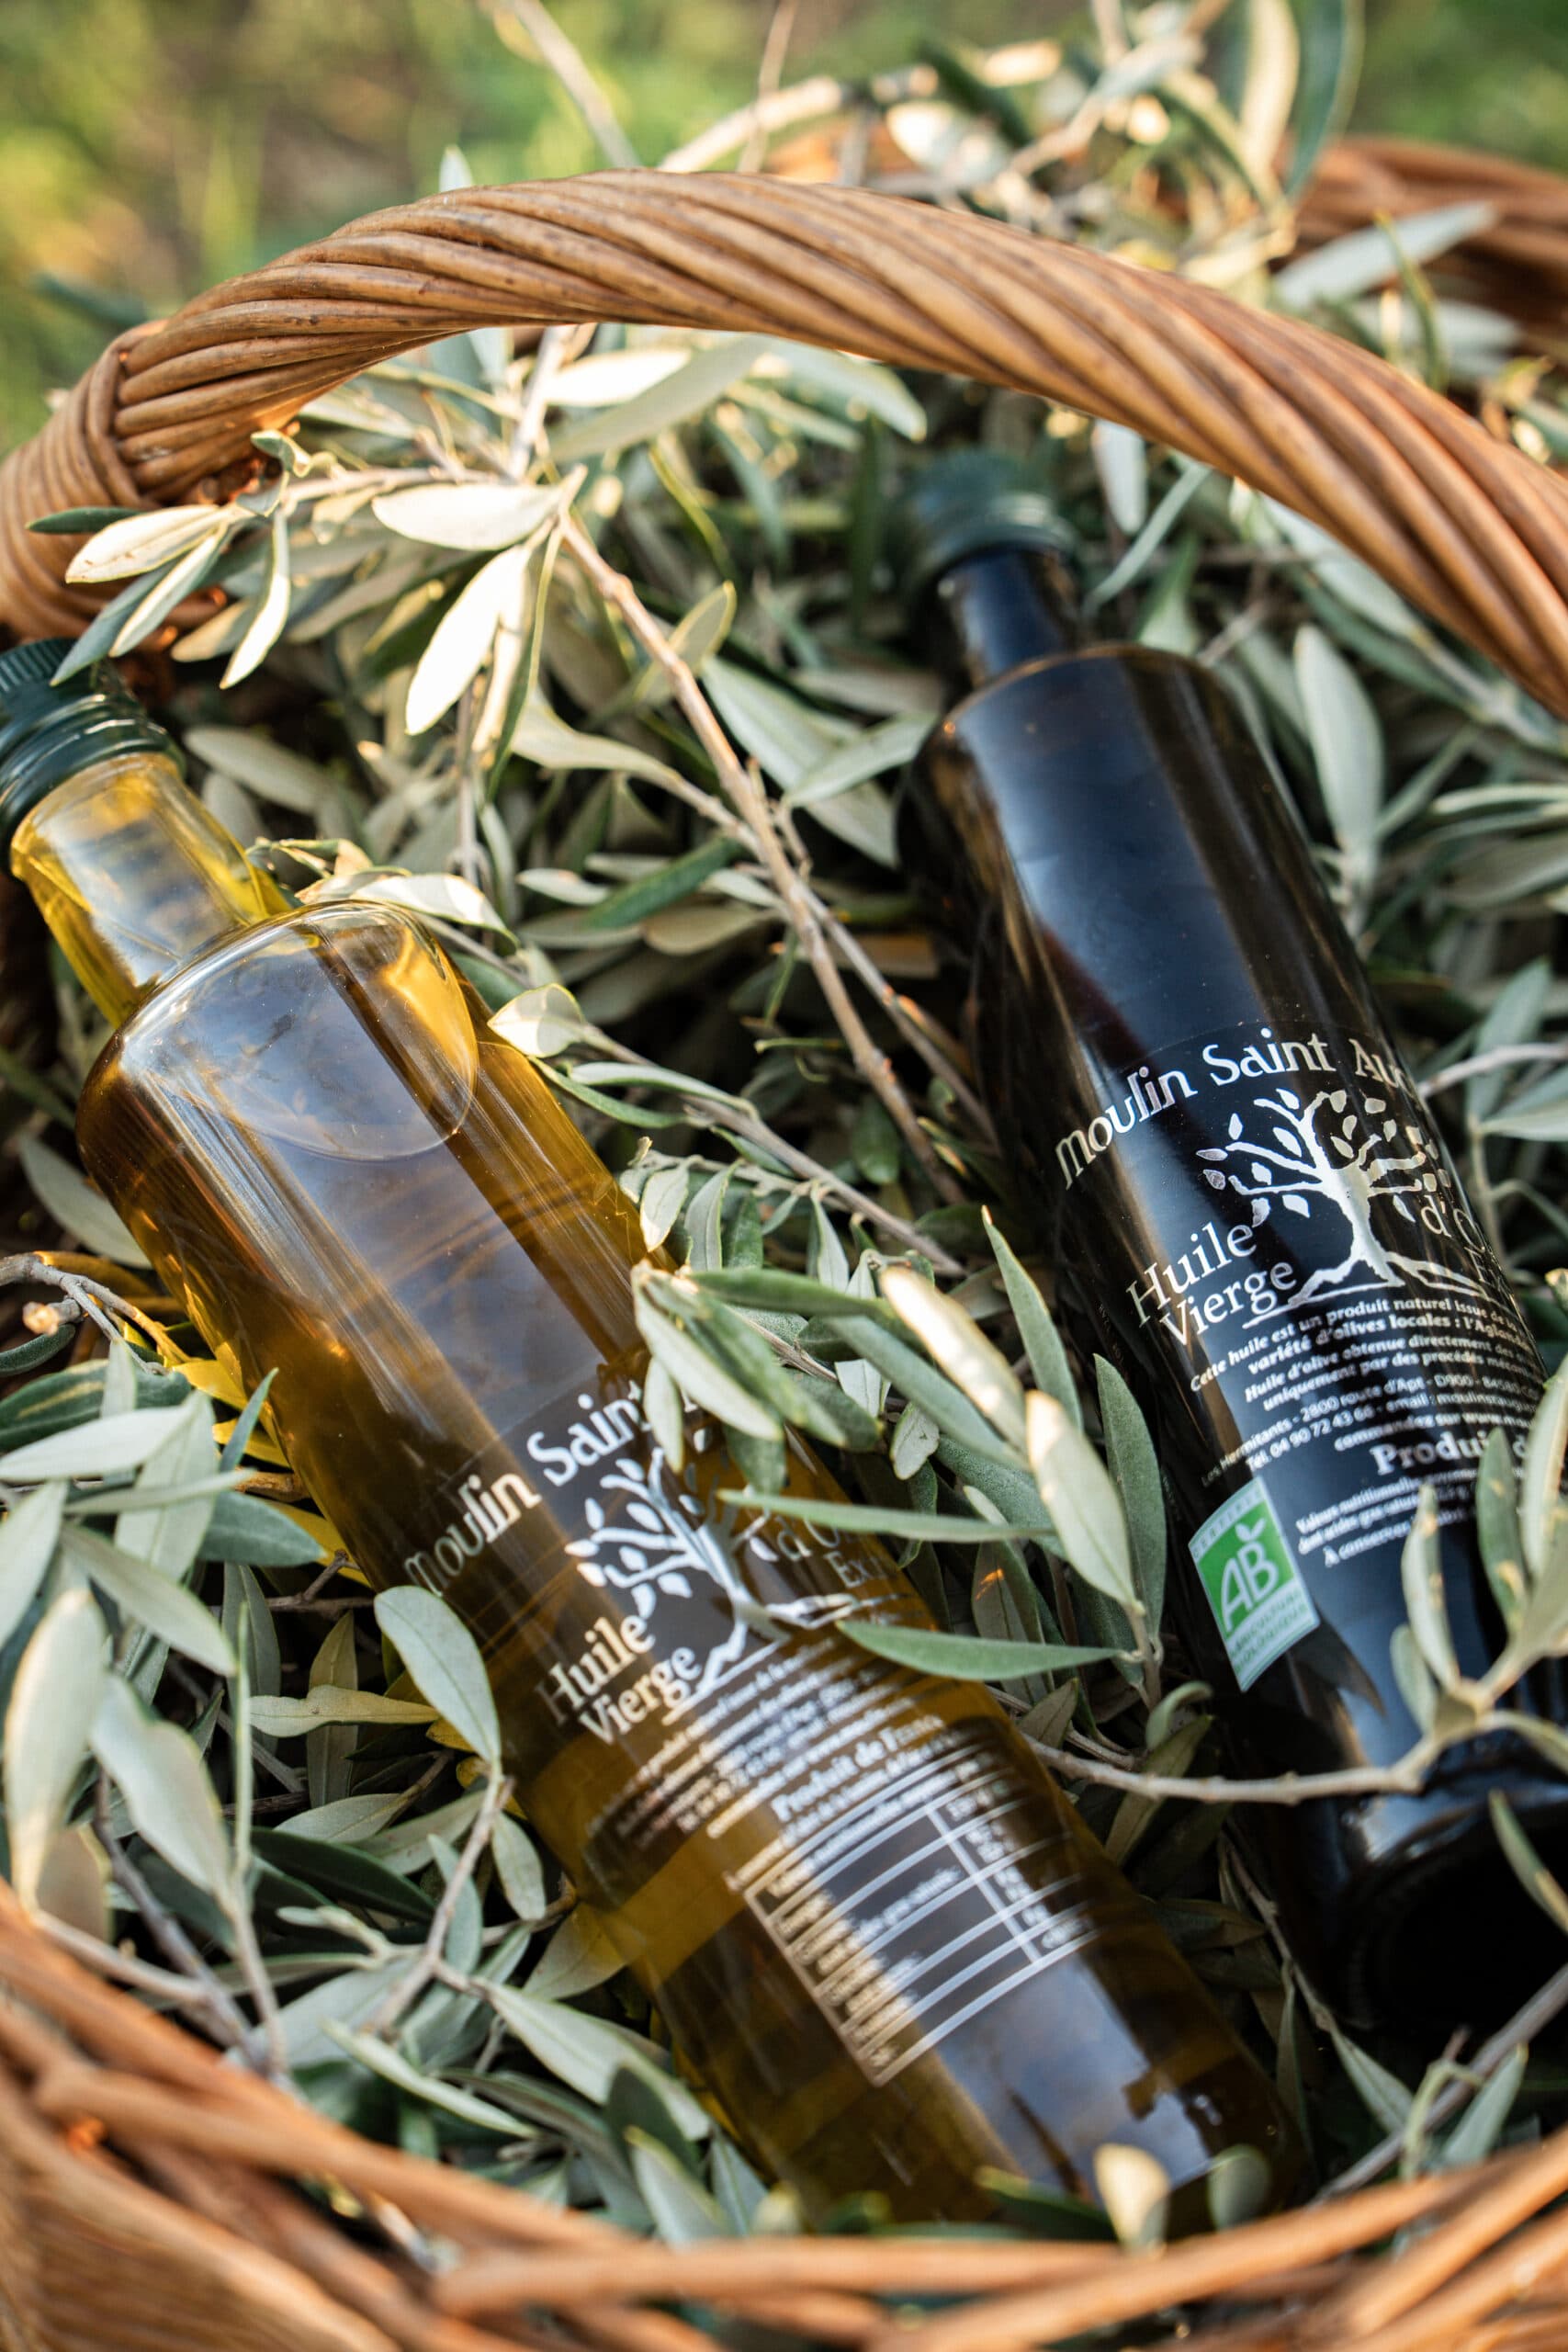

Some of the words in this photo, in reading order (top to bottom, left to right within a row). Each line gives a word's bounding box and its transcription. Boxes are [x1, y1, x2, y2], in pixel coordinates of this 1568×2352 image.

[1055, 1066, 1199, 1190] moulin
[1201, 1027, 1337, 1087] Saint
[1126, 1221, 1258, 1329] Huile
[1159, 1261, 1297, 1346] Vierge
[1190, 1359, 1227, 1393] Cette
[1227, 1335, 1269, 1367] huile
[1270, 1322, 1296, 1344] est
[1298, 1315, 1324, 1332] un
[1325, 1297, 1391, 1325] produit
[1393, 1296, 1453, 1311] naturel
[1453, 1299, 1488, 1319] issue
[1244, 1371, 1287, 1404] Huile
[1287, 1351, 1340, 1381] d'olive
[1341, 1337, 1406, 1361] obtenue
[1407, 1333, 1493, 1351] directement
[1247, 1334, 1314, 1376] variété
[1314, 1317, 1387, 1346] d'olives
[1388, 1313, 1451, 1329] locales
[1262, 1363, 1358, 1412] uniquement
[1359, 1355, 1391, 1376] par
[1390, 1351, 1420, 1368] des
[1421, 1349, 1485, 1367] procédés
[1218, 1417, 1293, 1472] Hermitants
[1300, 1395, 1340, 1423] 2800
[1339, 1384, 1382, 1408] route
[1383, 1376, 1425, 1396] d'Apt
[1245, 1449, 1272, 1472] Tél.
[1270, 1436, 1291, 1459] 04
[1290, 1426, 1312, 1448] 90
[1309, 1417, 1332, 1439] 72
[1332, 1408, 1354, 1429] 43
[1385, 1392, 1429, 1413] email
[1333, 1414, 1436, 1453] commandez
[1434, 1412, 1462, 1426] sur
[404, 1474, 543, 1597] moulin
[1221, 1540, 1280, 1633] AB
[535, 1614, 657, 1726] Huile
[577, 1646, 704, 1746] Vierge
